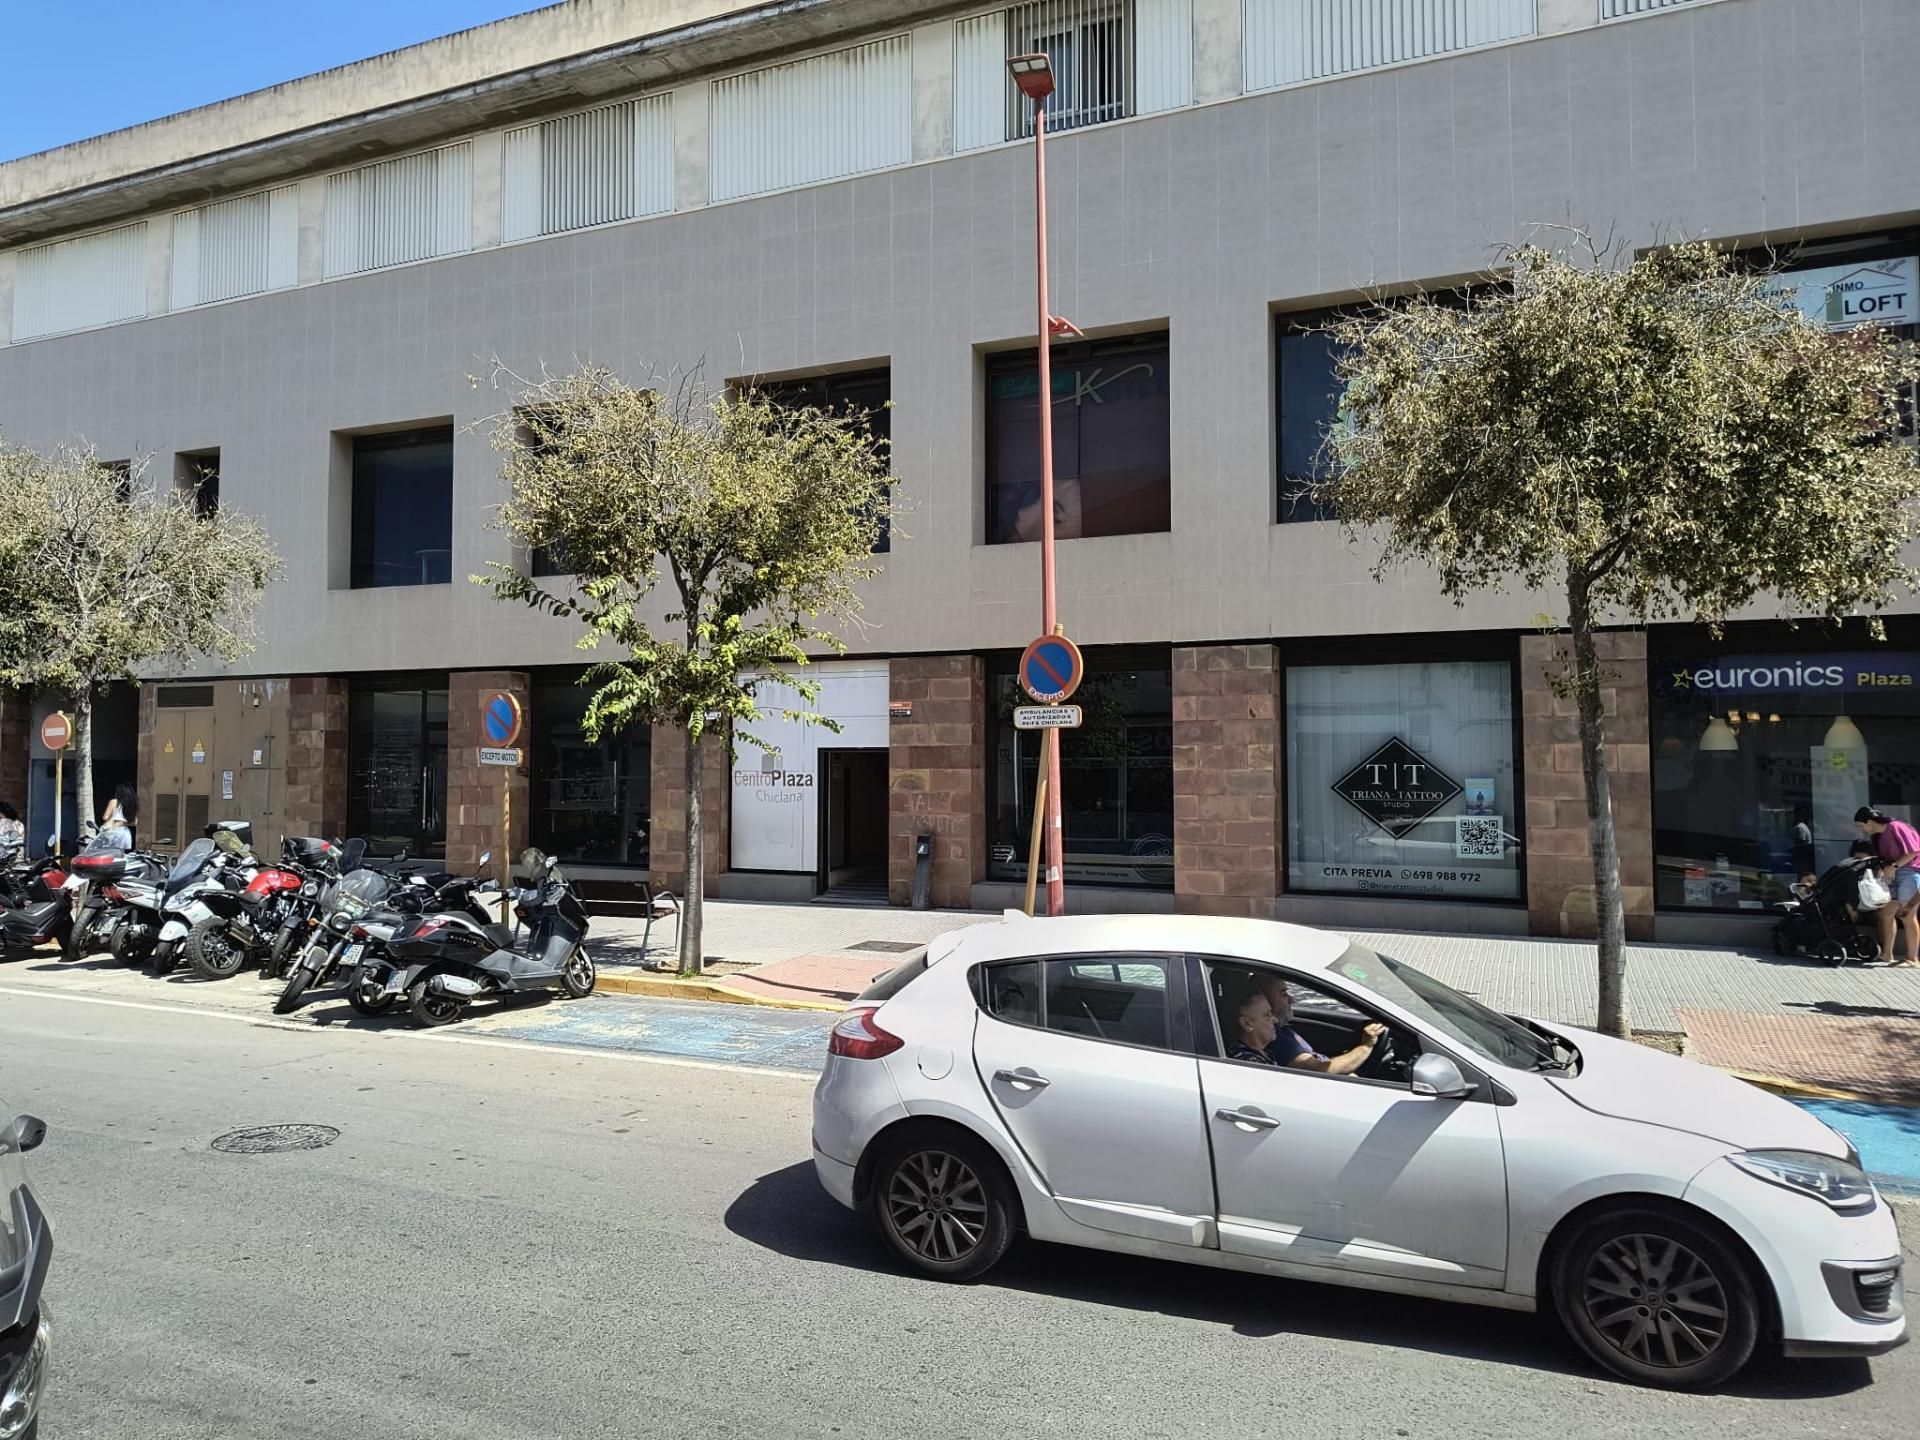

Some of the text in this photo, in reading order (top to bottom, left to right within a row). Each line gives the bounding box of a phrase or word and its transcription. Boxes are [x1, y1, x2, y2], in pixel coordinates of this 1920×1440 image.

[1844, 292, 1907, 316] LOFT
[1693, 660, 1913, 689] euronics Plaza
[1028, 686, 1065, 702] EXCEPTO
[481, 751, 501, 761] EXCEPTO
[755, 788, 803, 804] Chiclana
[1350, 790, 1444, 800] TRIANA TATTOO
[1323, 866, 1481, 882] CITA PREVIA 698 988 972
